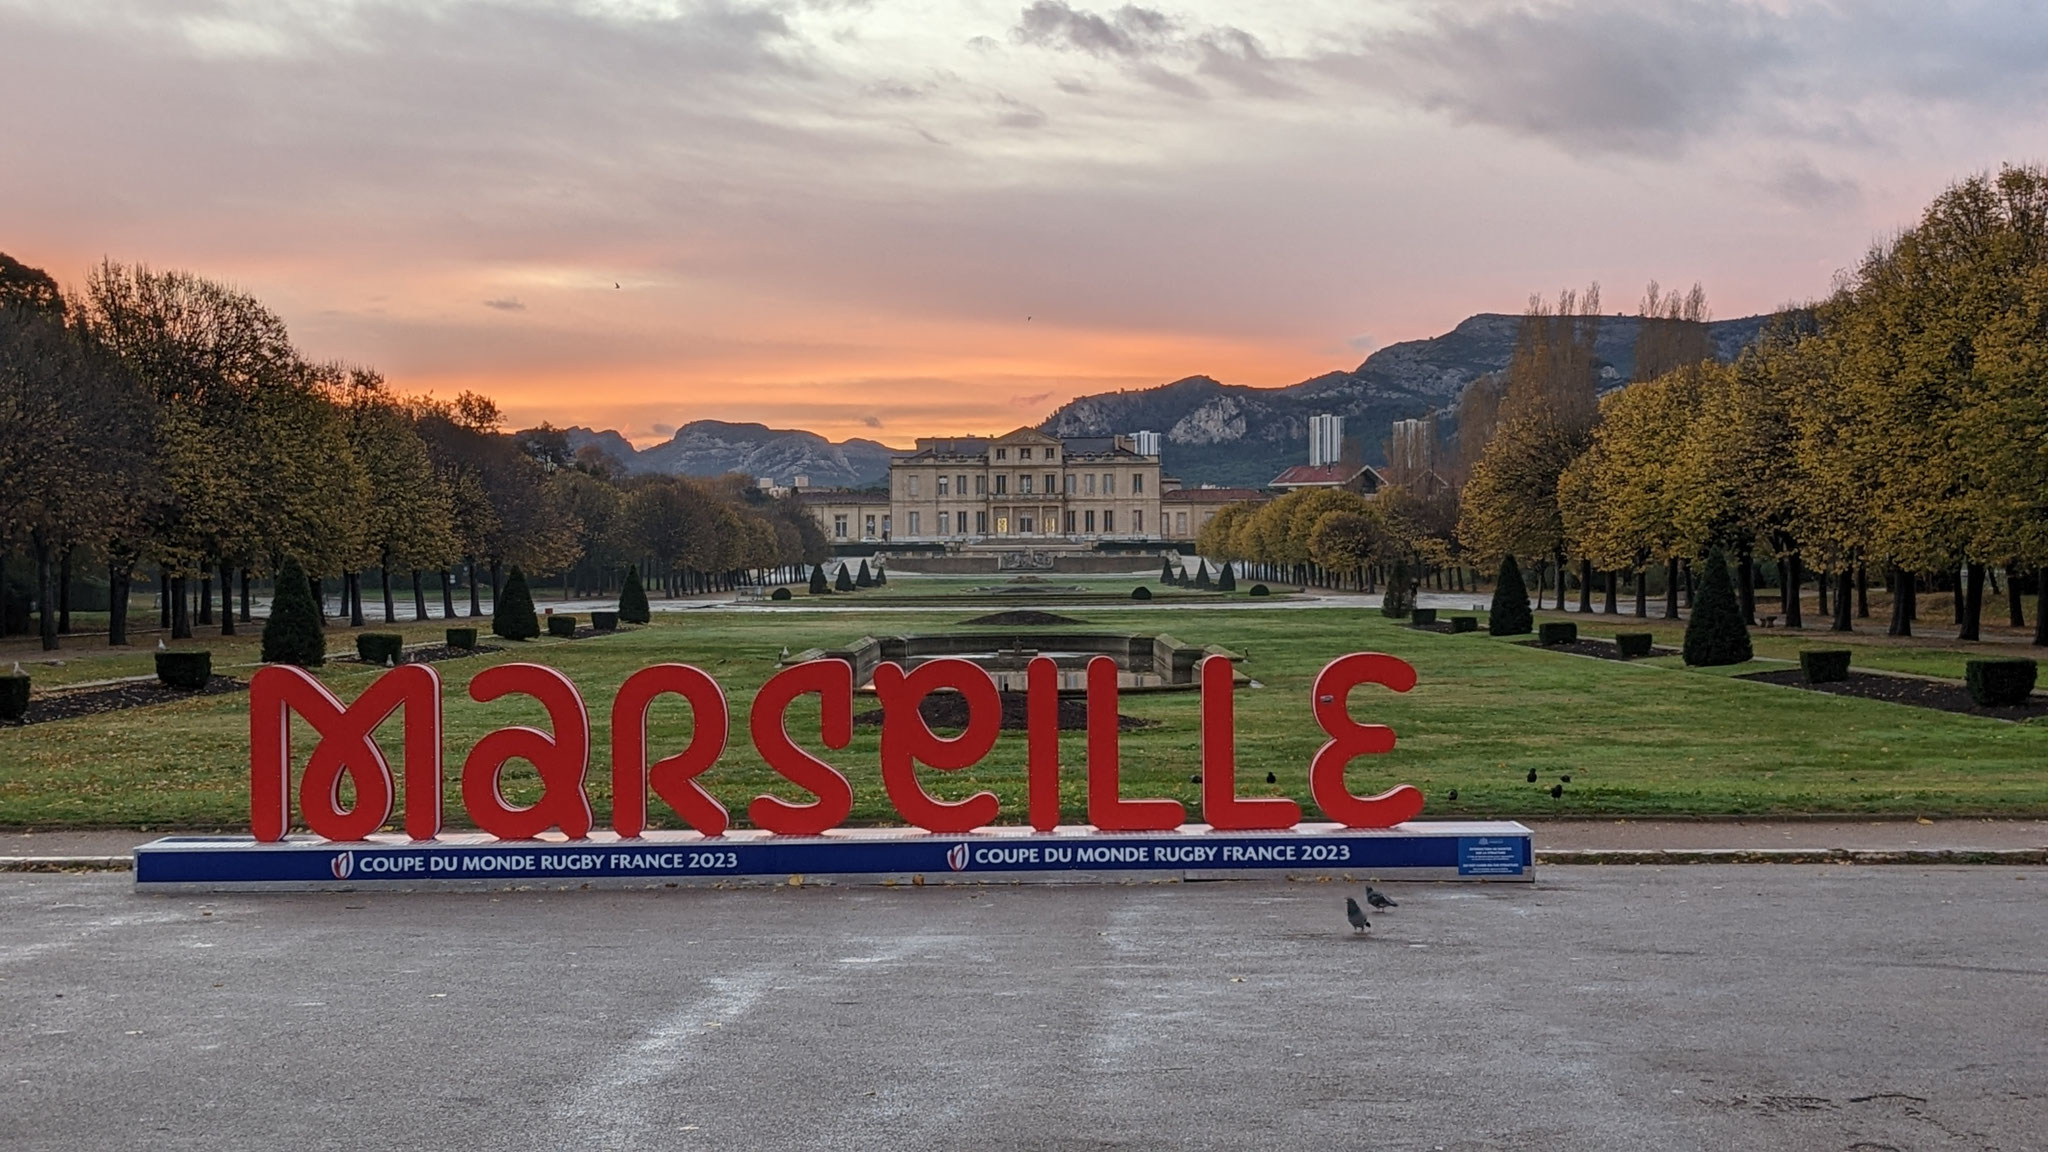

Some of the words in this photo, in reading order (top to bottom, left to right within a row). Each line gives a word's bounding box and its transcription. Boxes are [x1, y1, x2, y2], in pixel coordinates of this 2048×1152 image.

[360, 857, 425, 872] COUPE
[430, 857, 458, 871] DU
[462, 856, 536, 871] MONDE
[541, 855, 605, 871] RUGBY
[610, 854, 684, 869] FRANCE
[688, 853, 738, 868] 2023
[975, 849, 1040, 864] COUPE
[1044, 848, 1072, 863] DU
[1076, 847, 1149, 863] MONDE
[1154, 846, 1218, 862] RUGBY
[1223, 845, 1297, 861] FRANCE
[1301, 845, 1350, 860] 2023
